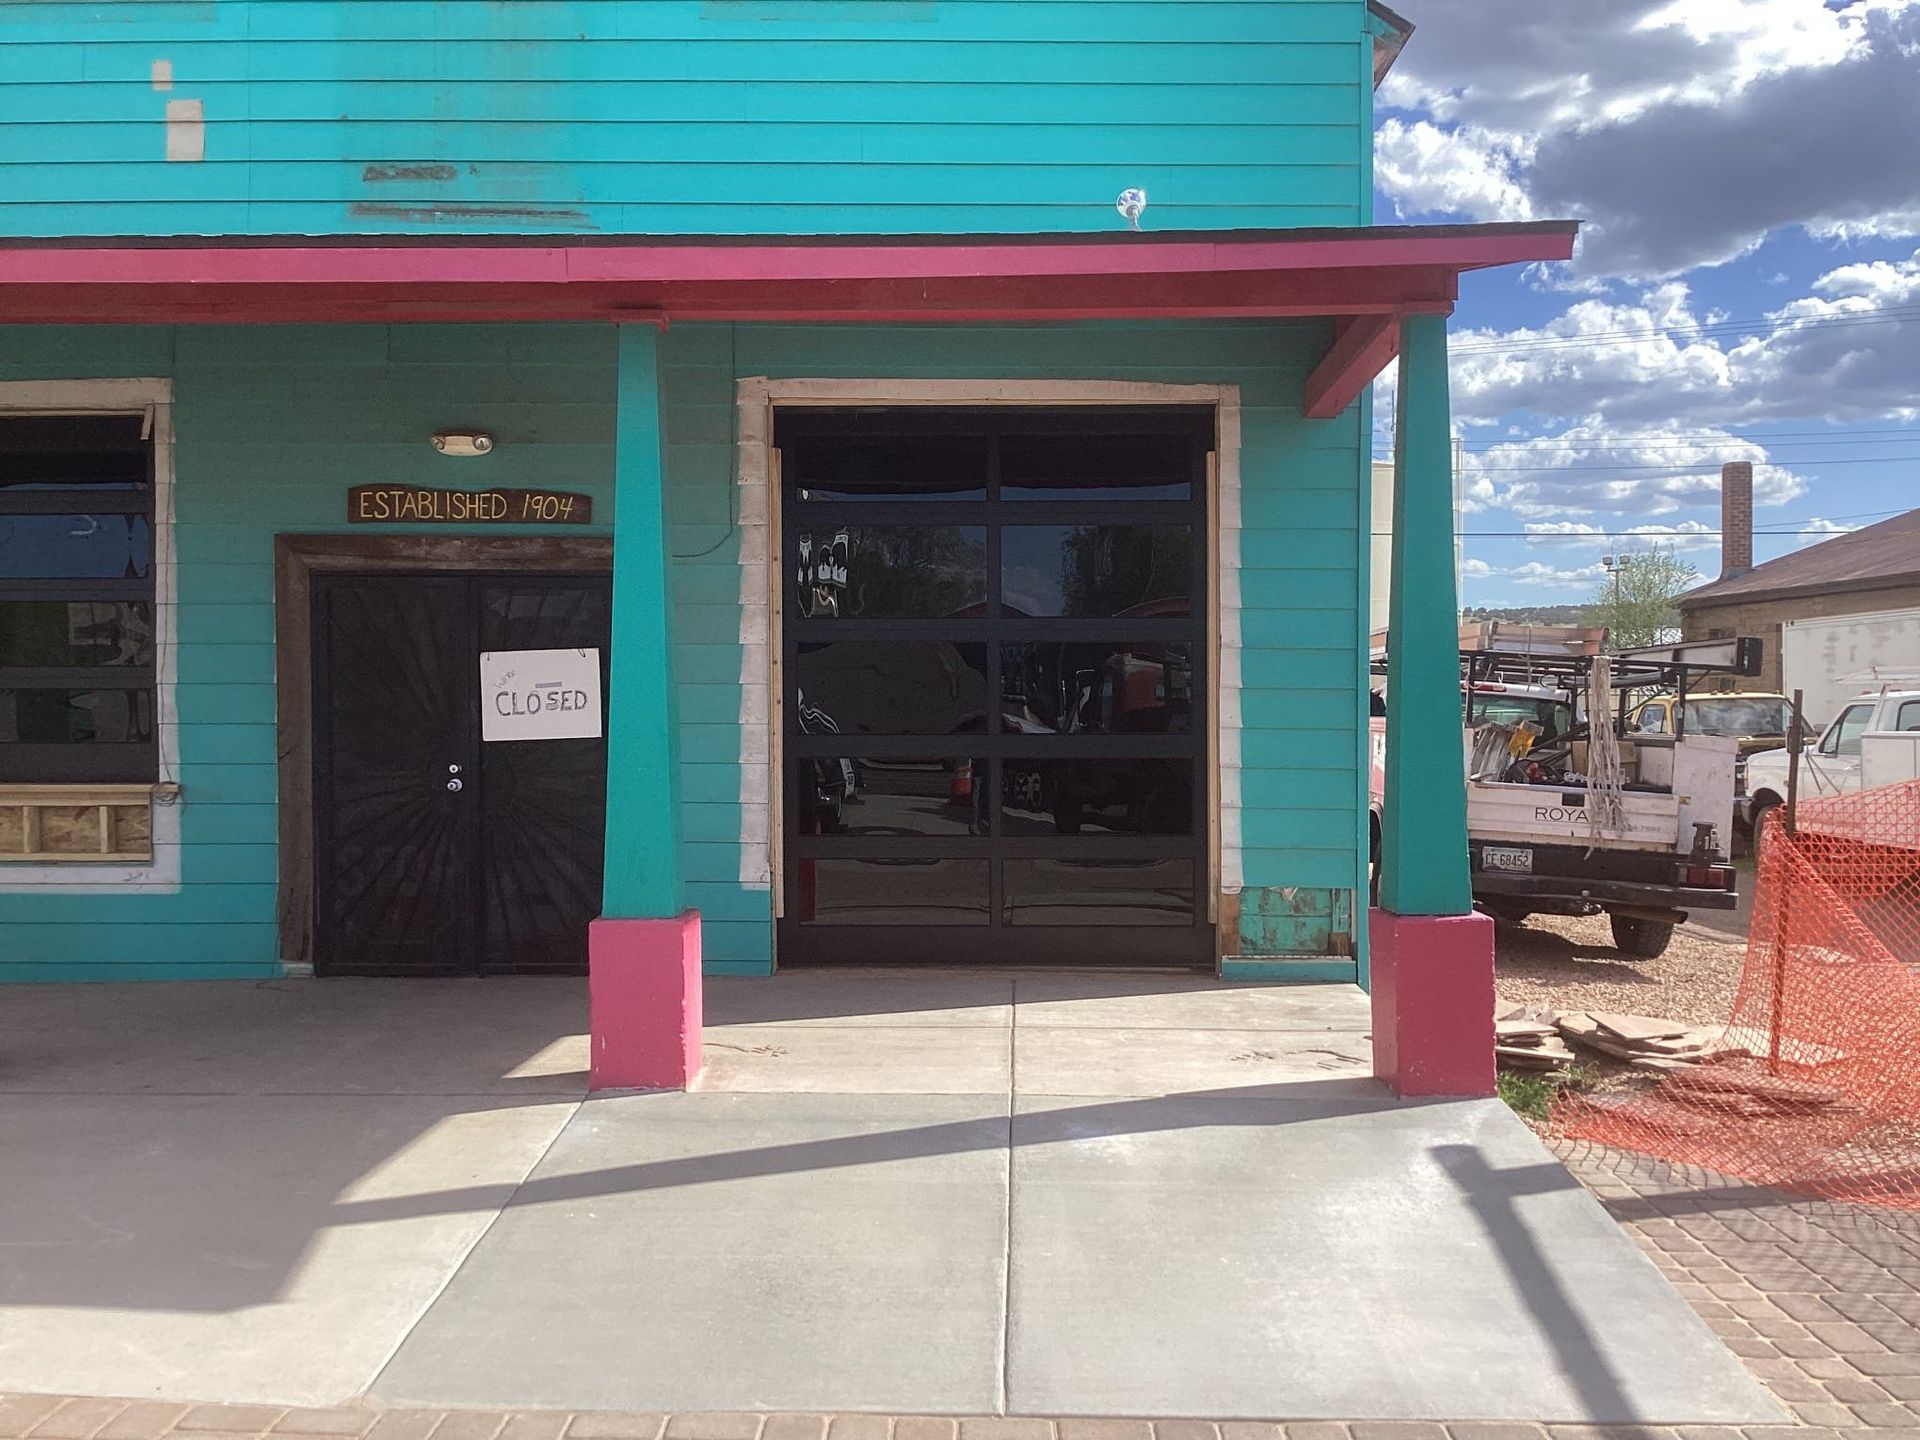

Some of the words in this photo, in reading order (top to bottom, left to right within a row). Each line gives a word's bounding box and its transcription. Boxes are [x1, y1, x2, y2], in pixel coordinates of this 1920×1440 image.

[359, 491, 508, 520] ESTABLISHED
[521, 493, 575, 520] 1904
[495, 689, 588, 717] CLOSED
